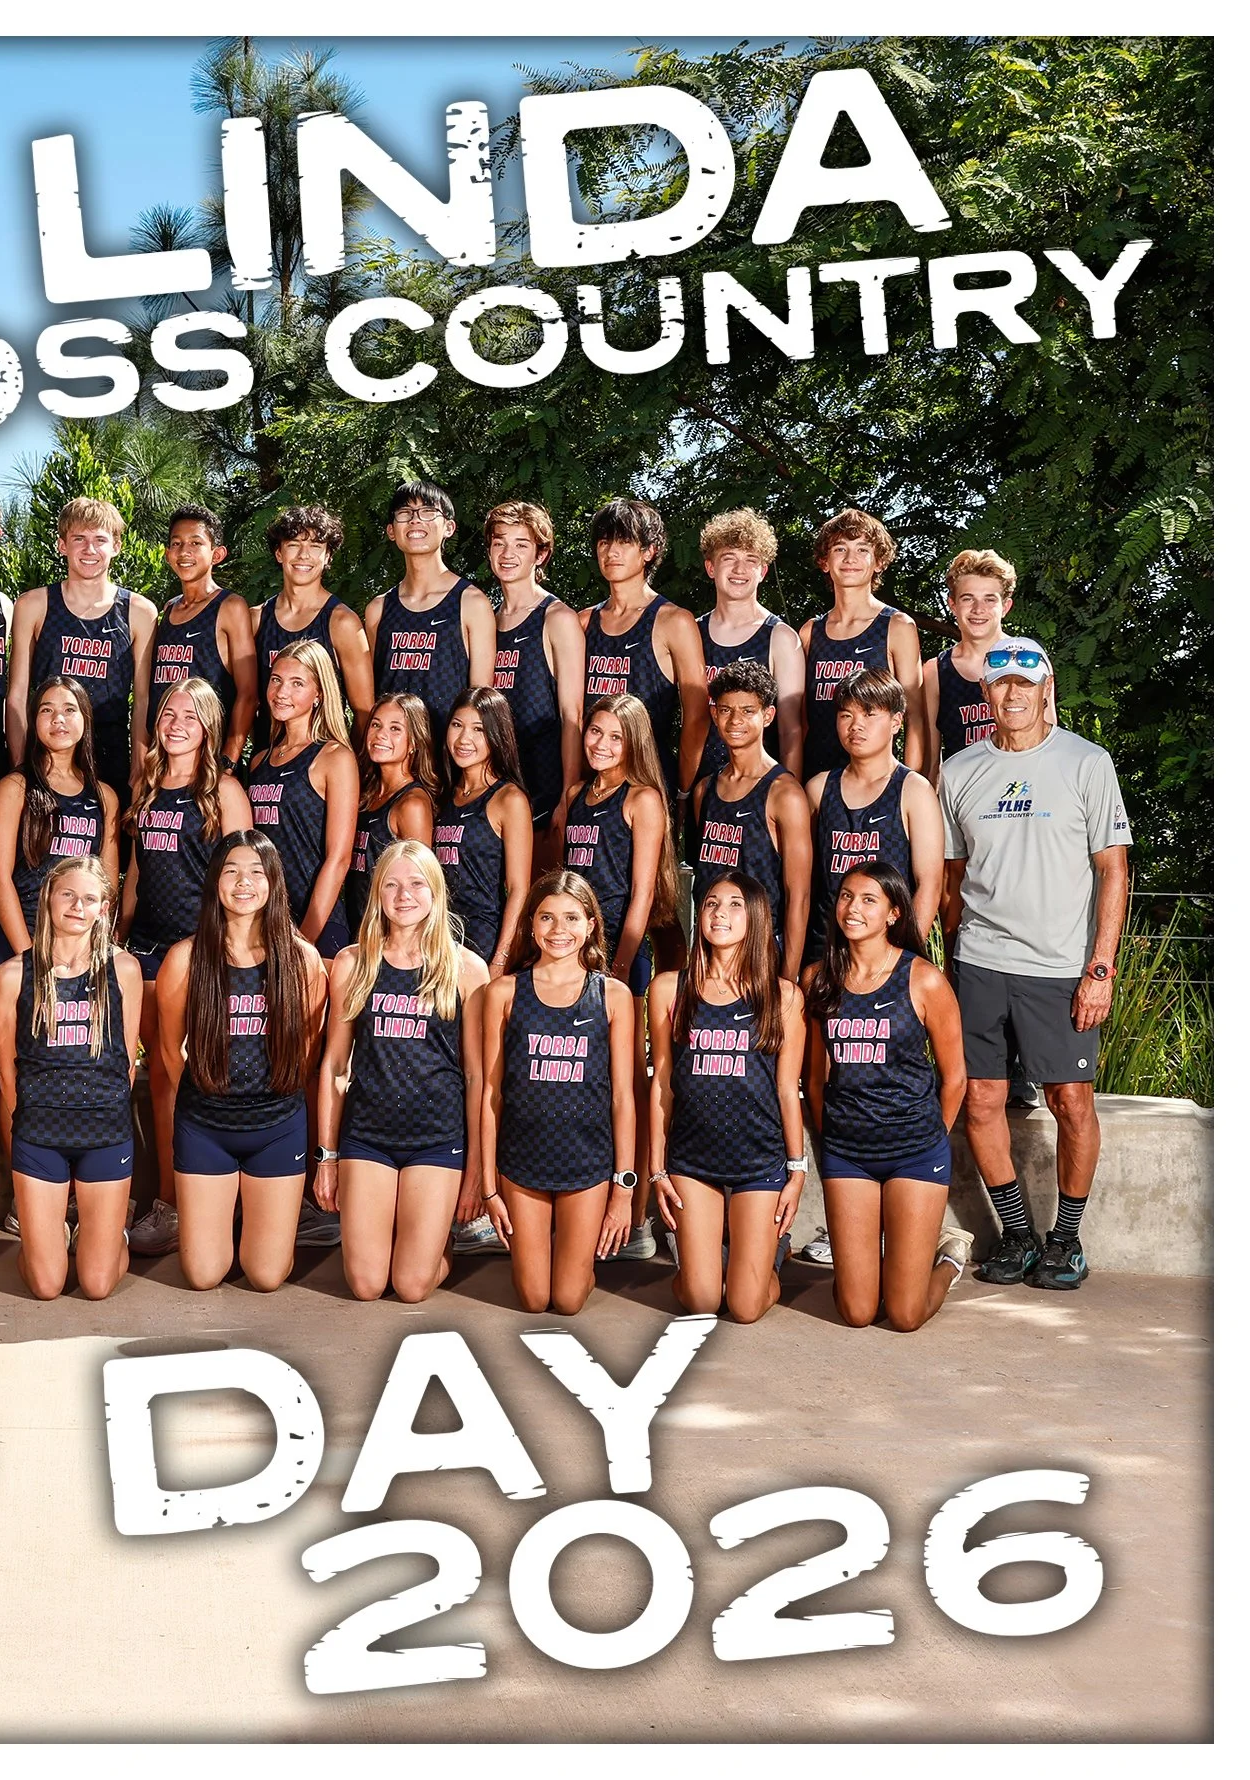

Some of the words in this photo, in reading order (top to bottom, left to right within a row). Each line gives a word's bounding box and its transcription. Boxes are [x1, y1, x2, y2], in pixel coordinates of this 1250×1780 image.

[61, 636, 112, 658] YORBA
[391, 632, 437, 650] YORBA
[61, 658, 108, 679] LINDA
[390, 652, 431, 671] LINDA
[495, 650, 520, 668] RBA
[588, 655, 631, 674] YORBA
[494, 671, 515, 689] NDA
[587, 676, 627, 695] LINDA
[815, 682, 839, 701] LIN
[997, 799, 1033, 813] YLHS
[703, 821, 744, 845] YORBA
[831, 830, 880, 851] YORBA
[700, 843, 739, 867] LINDA
[229, 994, 268, 1014] ORB
[373, 1016, 428, 1039] LINDA
[827, 1018, 891, 1039] YORBA
[528, 1033, 589, 1057] YORBA
[689, 1028, 749, 1051] YORBA
[833, 1042, 886, 1064] LINDA
[529, 1059, 584, 1082] LINDA
[692, 1054, 746, 1077] LINDA
